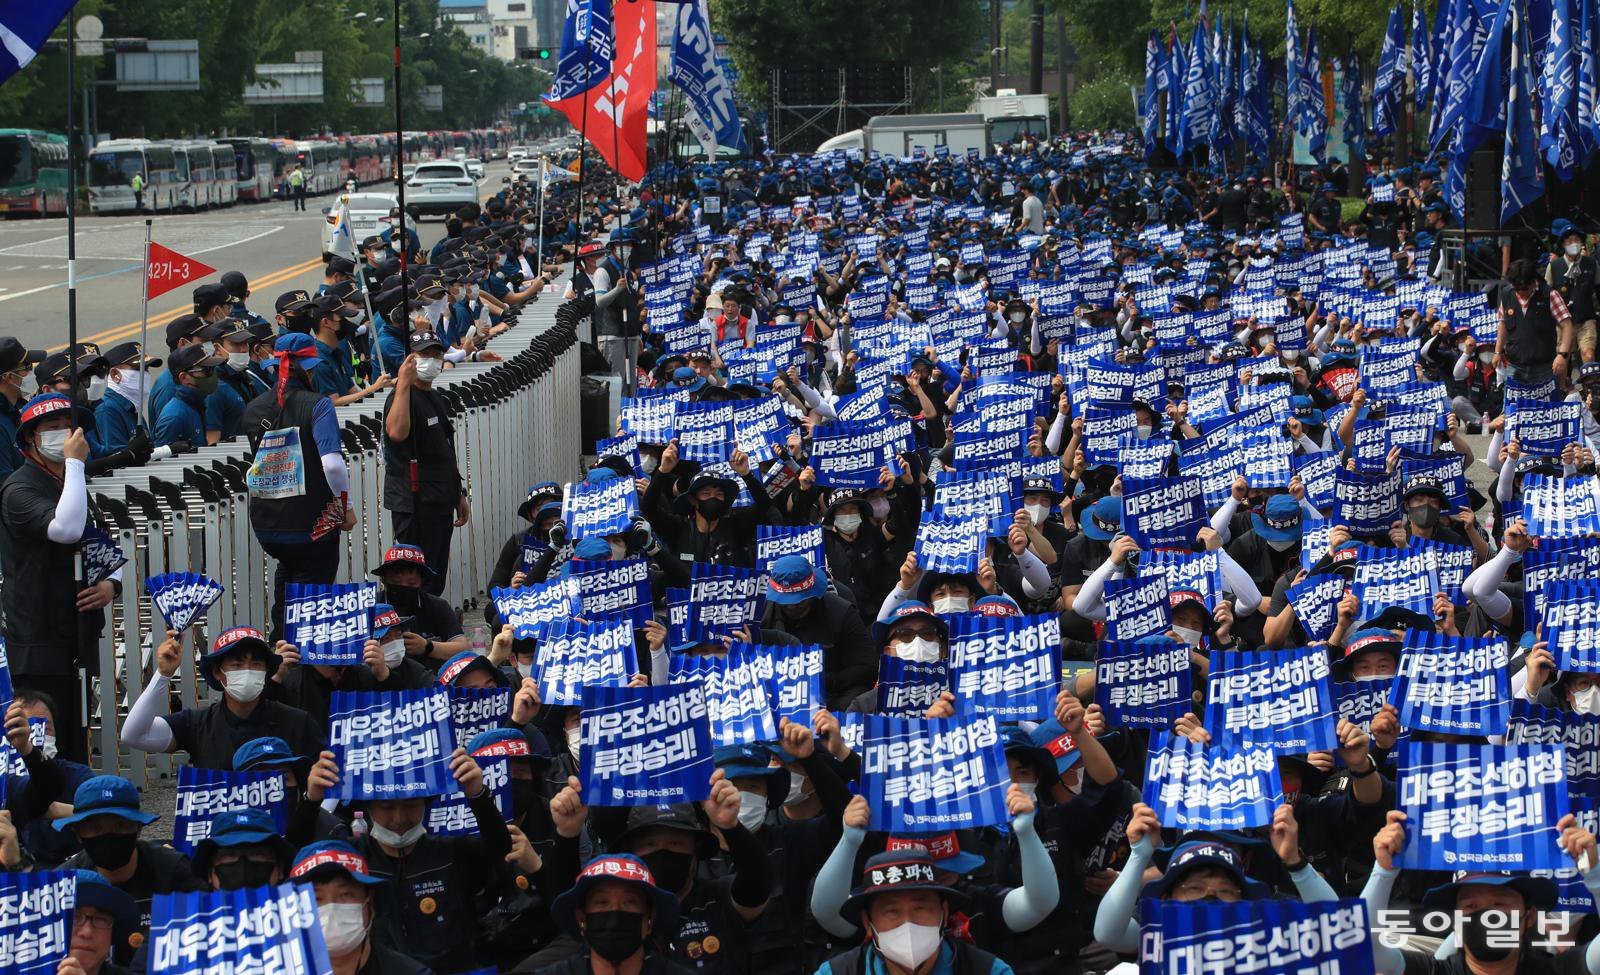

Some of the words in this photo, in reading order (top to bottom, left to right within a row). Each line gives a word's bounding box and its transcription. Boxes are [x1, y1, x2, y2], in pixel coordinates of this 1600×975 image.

[978, 350, 1018, 368] 대우조선하청
[1185, 365, 1234, 386] 대우조선하청
[1370, 370, 1410, 388] 투쟁승리!
[674, 406, 733, 430] 대우조선하청
[982, 398, 1033, 421] 대우조선하청
[987, 414, 1026, 432] 투쟁승리!
[1083, 413, 1137, 436] 대우조선하청
[680, 425, 727, 446] 투쟁승리!
[813, 431, 883, 455] 대우조선하청
[955, 432, 1020, 460] 대우조선하청
[1519, 423, 1563, 441] 투쟁승리!
[820, 452, 874, 473] 투쟁승리!
[935, 477, 1009, 504] 대우조선하청
[1125, 478, 1201, 517] 대우조선하청
[945, 498, 1003, 518] 투쟁승리!
[1138, 503, 1193, 533] 투쟁승리!
[1341, 498, 1398, 521] 투쟁승리!
[757, 528, 823, 559] 대우조선하청
[581, 562, 648, 591] 우조선하청
[1354, 549, 1437, 584] 대우조선하청
[286, 586, 376, 624] 대우조선하청
[583, 587, 638, 615] 투쟁승리!
[1363, 575, 1430, 605] 투쟁승리!
[296, 615, 367, 646] 투쟁승리!
[538, 624, 631, 664] 대우조선하청
[950, 617, 1060, 668] 대우조선하청
[543, 652, 624, 688] 투쟁승리!
[958, 654, 1052, 698] 투쟁승리!
[1097, 648, 1190, 685] 대우조선하청
[1400, 641, 1509, 679] 대우조선하청
[1110, 678, 1178, 708] 투쟁승리!
[1209, 651, 1330, 705] 대우조선하청
[1409, 675, 1495, 707] 투쟁승리!
[331, 690, 450, 747] 대우조선하청
[452, 691, 509, 724] 조선하청
[580, 685, 706, 747] 대우조선하청
[1225, 688, 1318, 734] 투쟁승리!
[346, 729, 439, 776] 투쟁승리!
[594, 728, 697, 780] 투쟁승리!
[865, 715, 998, 774] 대우조선하청
[1149, 747, 1275, 782] 대우조선하청
[1401, 749, 1563, 806] 대우조선하청
[175, 774, 285, 817] 대우조선하청
[884, 756, 986, 807] 투쟁승리!
[1159, 777, 1260, 810] 투쟁승리!
[1422, 793, 1542, 842] 투쟁승리!
[886, 864, 934, 884] 총파업
[1459, 853, 1523, 863] 전국금속노동조합
[152, 890, 315, 972] 대우조선하청
[1169, 905, 1366, 975] 대우조선하청
